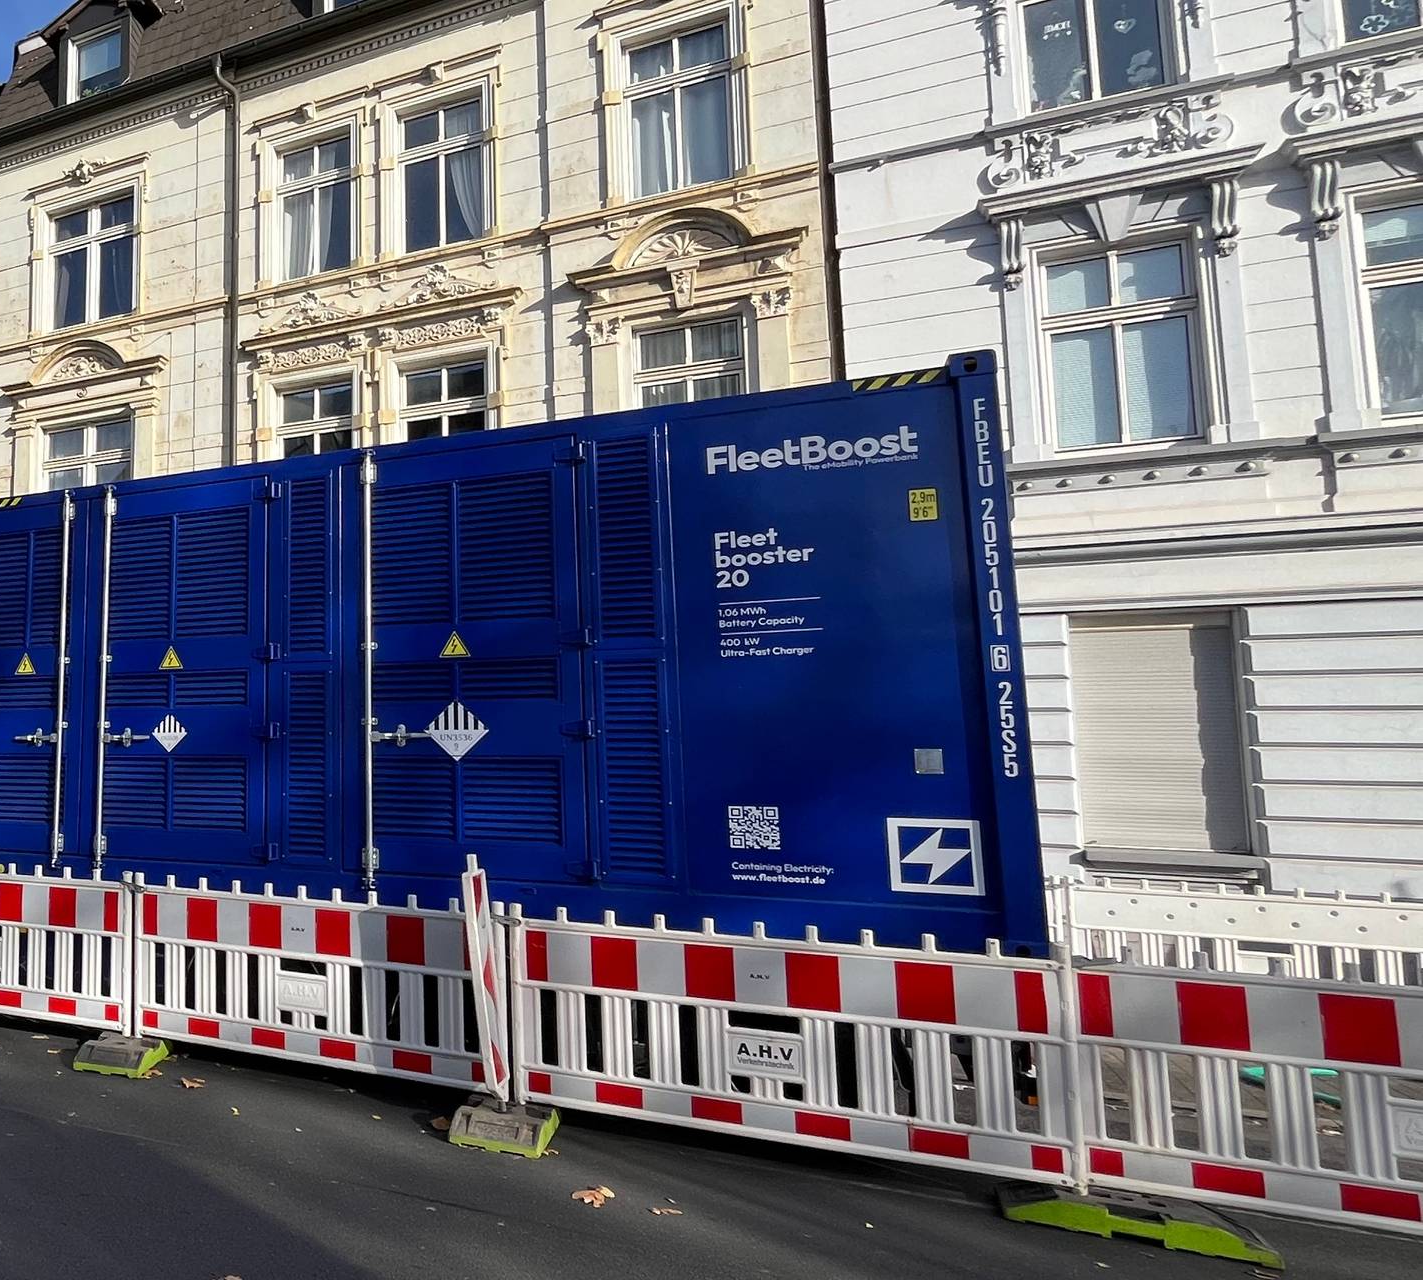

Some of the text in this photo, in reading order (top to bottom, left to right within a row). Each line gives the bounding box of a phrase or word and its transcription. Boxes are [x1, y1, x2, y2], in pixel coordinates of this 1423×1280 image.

[706, 426, 919, 475] FleetBoost
[803, 463, 820, 471] The
[865, 453, 919, 465] Powerbank
[911, 491, 936, 505] 2,9m
[714, 528, 778, 550] Fleet
[715, 545, 814, 568] booster
[716, 569, 750, 589] 20
[973, 398, 1019, 777] FBEU 205101 6 25S5
[718, 606, 767, 618] 1,06 MWh
[718, 616, 805, 628] Battery Capacity
[720, 637, 760, 647] 400 kW
[720, 646, 815, 657] Ultra-Fast Charger
[731, 861, 834, 876] Containing Electricity:
[731, 873, 826, 885] www.fleetboost.de
[737, 1043, 794, 1061] A.H.V
